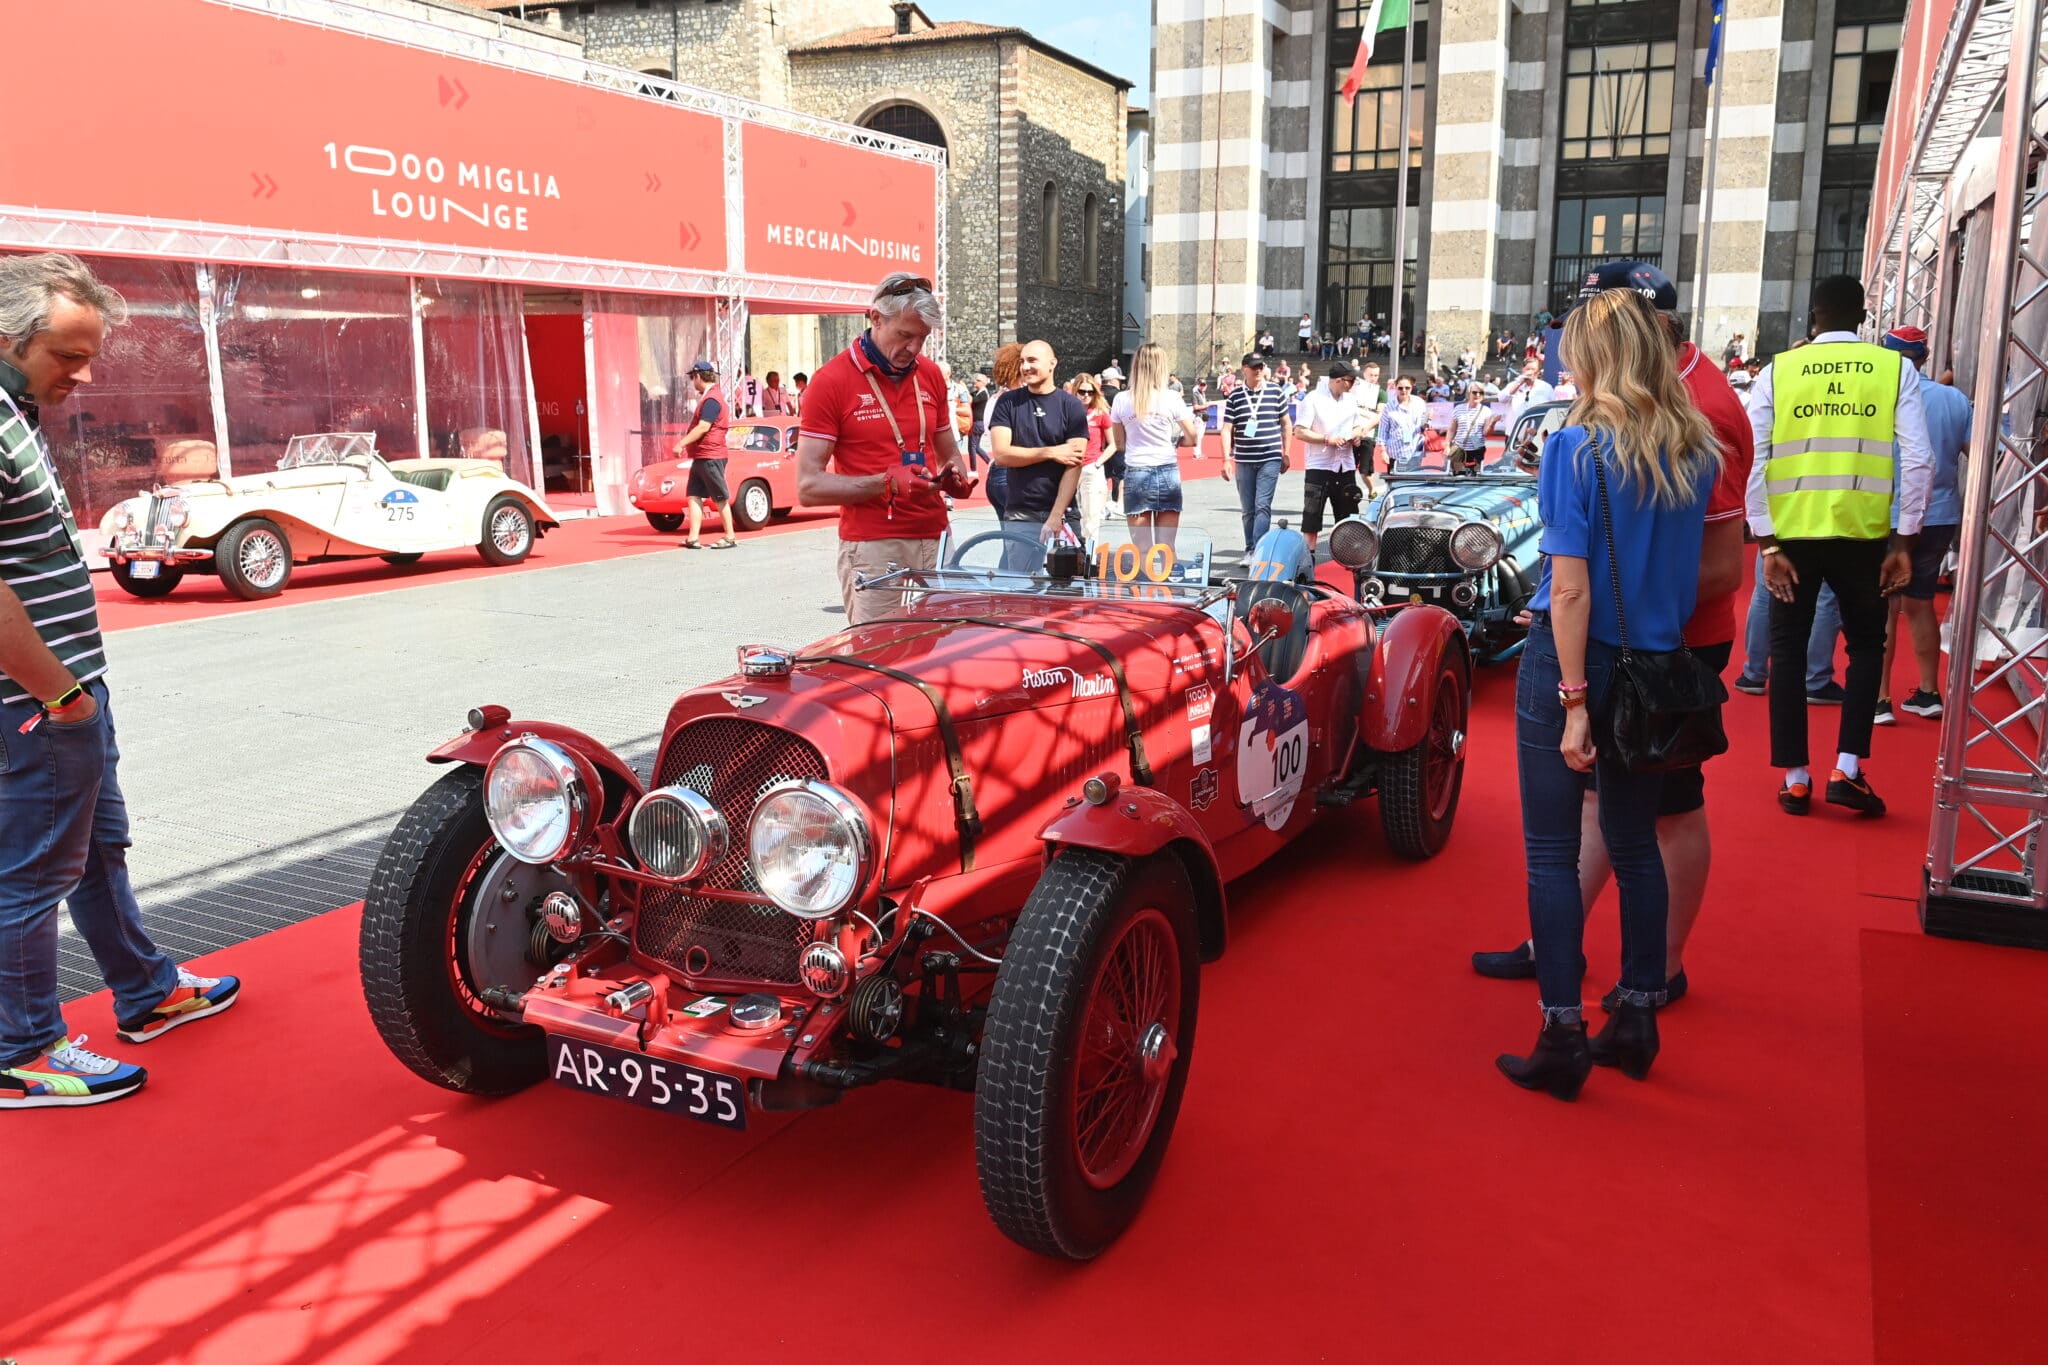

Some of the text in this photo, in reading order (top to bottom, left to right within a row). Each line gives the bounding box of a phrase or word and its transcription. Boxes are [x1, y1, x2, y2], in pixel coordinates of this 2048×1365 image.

[323, 142, 561, 200] 1000 MIGLIA
[372, 188, 529, 231] LOUNGE
[767, 223, 921, 263] MERCHANDISING
[1801, 361, 1874, 376] ADDETTO
[1827, 382, 1845, 395] AL
[1793, 402, 1877, 419] CONTROLLO
[387, 507, 415, 522] 275
[1095, 542, 1174, 582] 100
[1022, 666, 1116, 698] Aston Martin
[1189, 688, 1208, 702] 1000
[1271, 734, 1301, 788] 100
